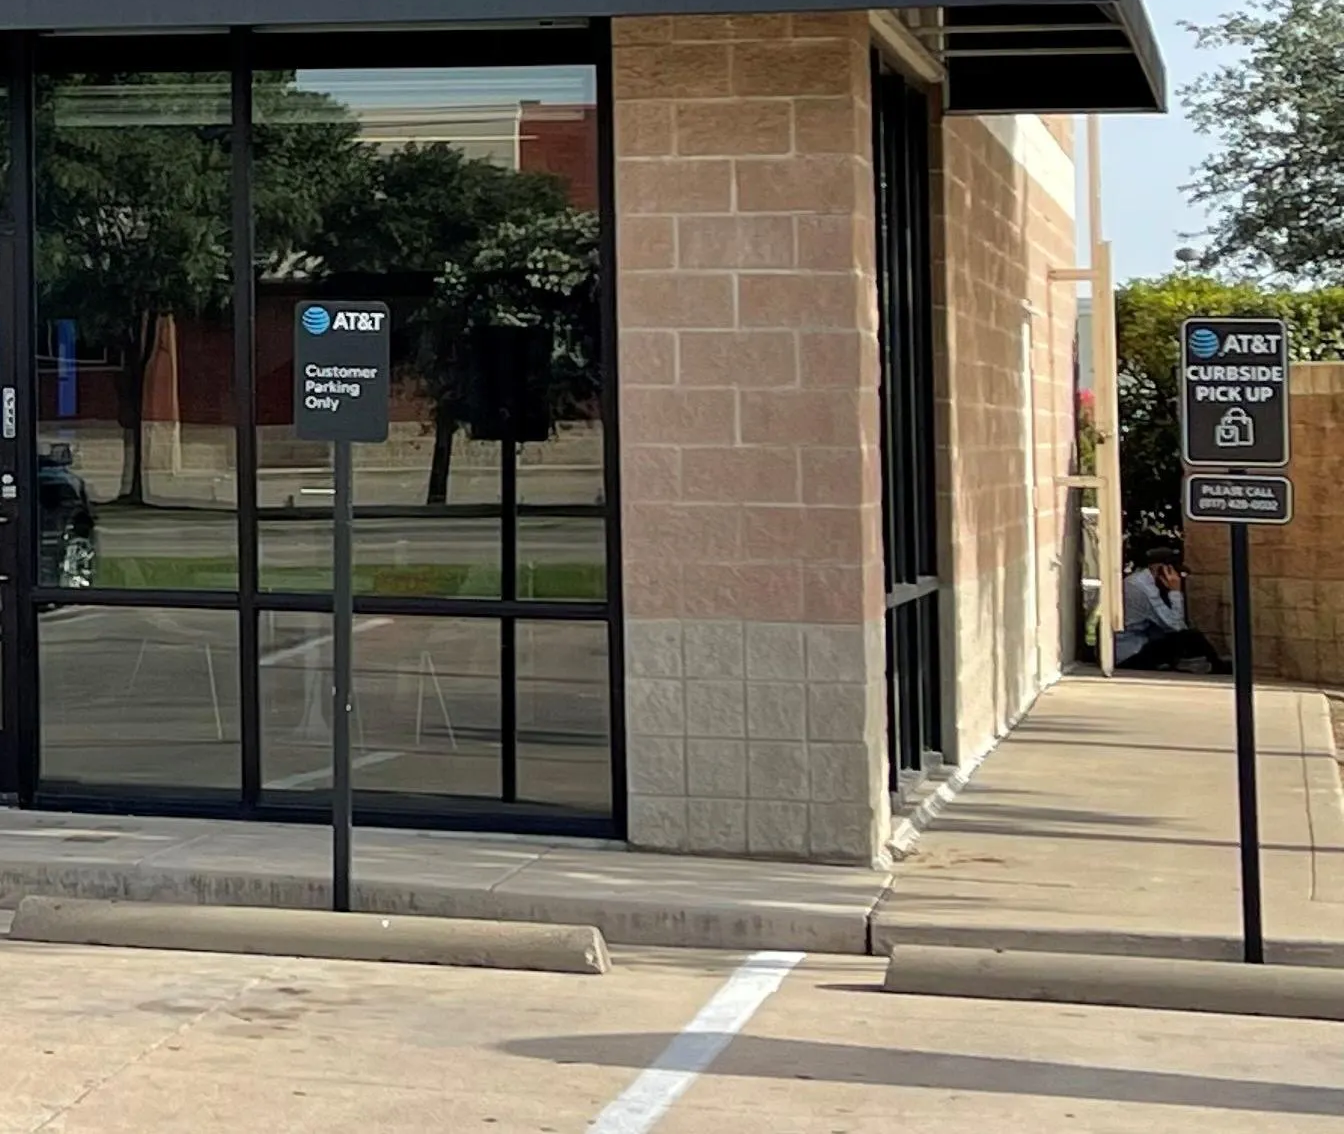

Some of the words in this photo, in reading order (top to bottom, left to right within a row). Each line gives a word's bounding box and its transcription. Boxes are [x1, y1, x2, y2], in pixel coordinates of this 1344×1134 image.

[332, 311, 385, 331] AT&T
[1222, 333, 1282, 354] AT&T
[305, 364, 378, 378] Customer
[1185, 365, 1284, 382] CURBSIDE
[305, 380, 360, 397] Parking
[1195, 386, 1243, 402] PICK
[1244, 386, 1274, 402] UP
[305, 396, 340, 412] Only
[1202, 485, 1244, 497] PLEASE
[1245, 486, 1275, 498] CALL
